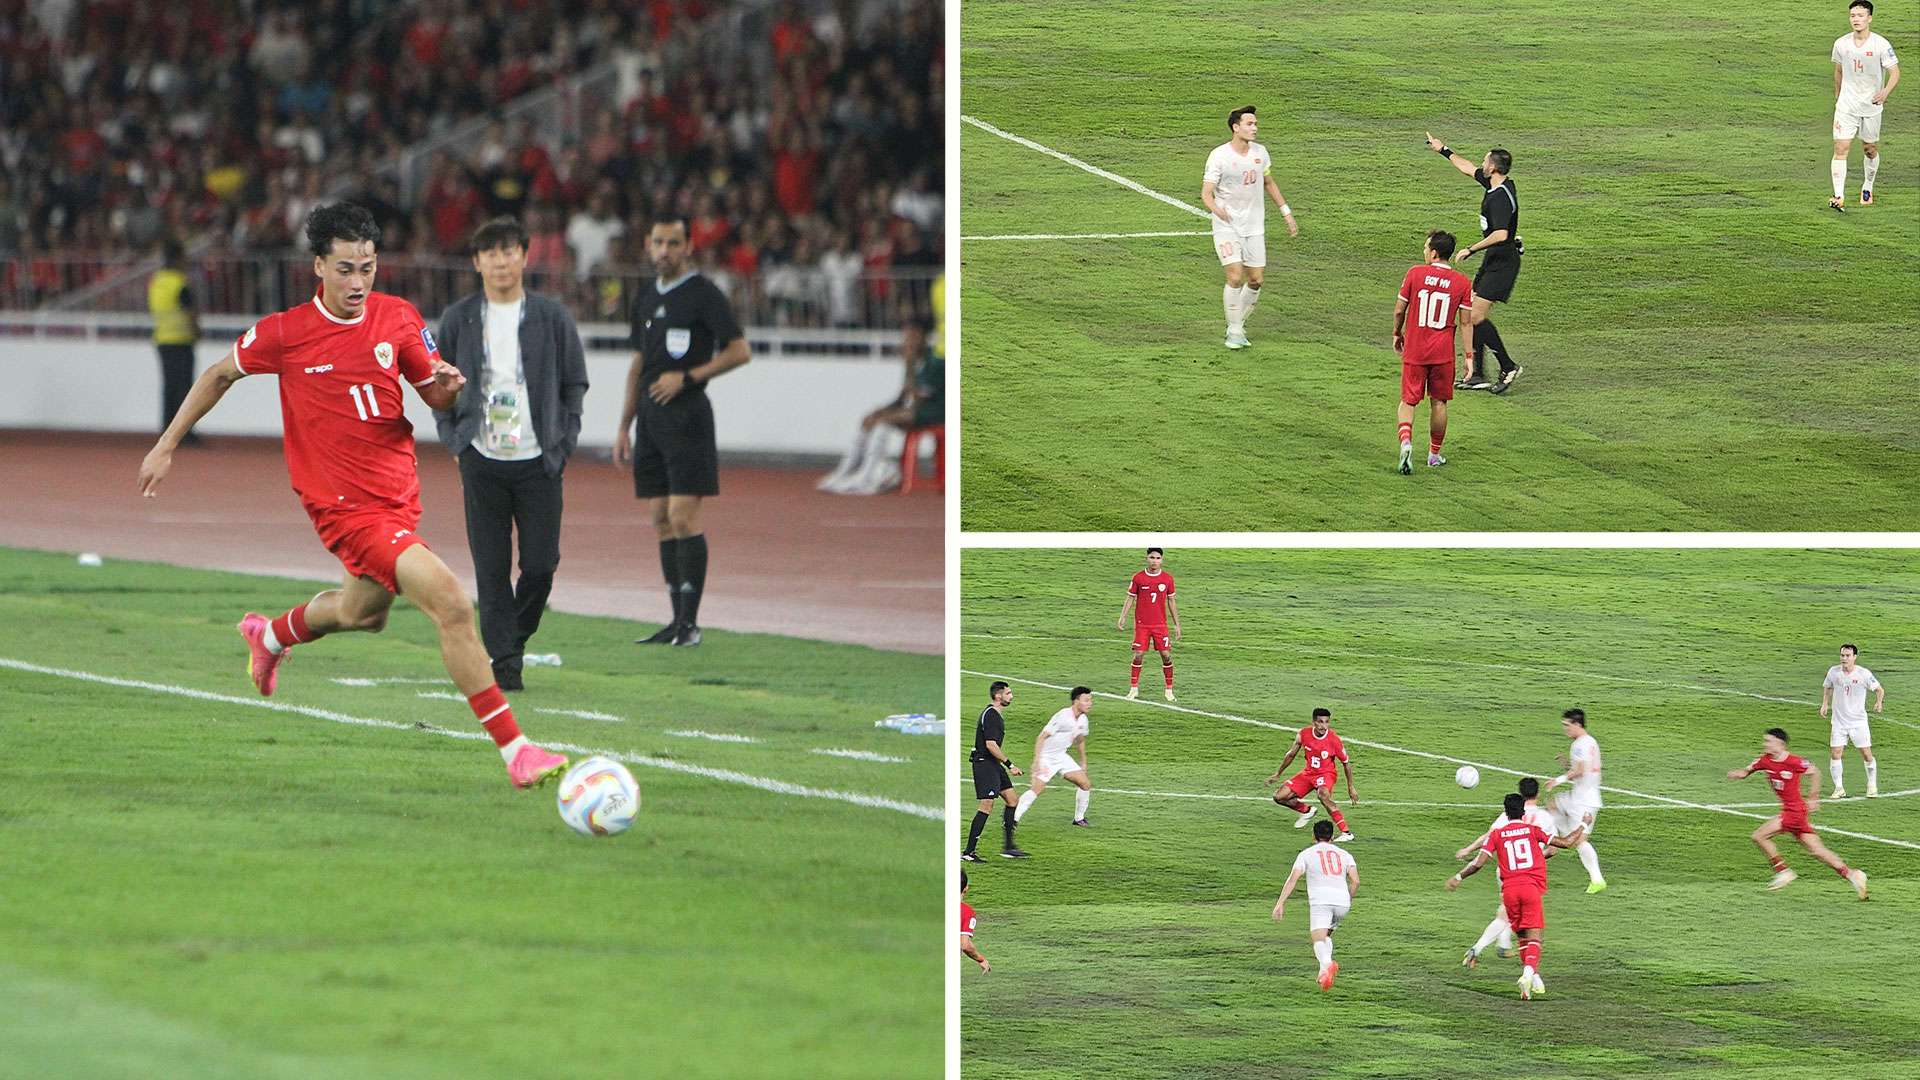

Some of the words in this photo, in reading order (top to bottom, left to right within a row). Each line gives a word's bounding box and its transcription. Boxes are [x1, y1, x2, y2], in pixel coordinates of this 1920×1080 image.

[1853, 59, 1864, 73] 14
[1242, 169, 1257, 186] 20
[1417, 288, 1451, 330] 10
[304, 364, 334, 374] erspo
[349, 383, 381, 421] 11
[1150, 592, 1157, 604] 7
[1162, 636, 1169, 648] 7
[1311, 755, 1321, 769] 15
[1504, 837, 1534, 871] 19
[1316, 850, 1343, 877] 10
